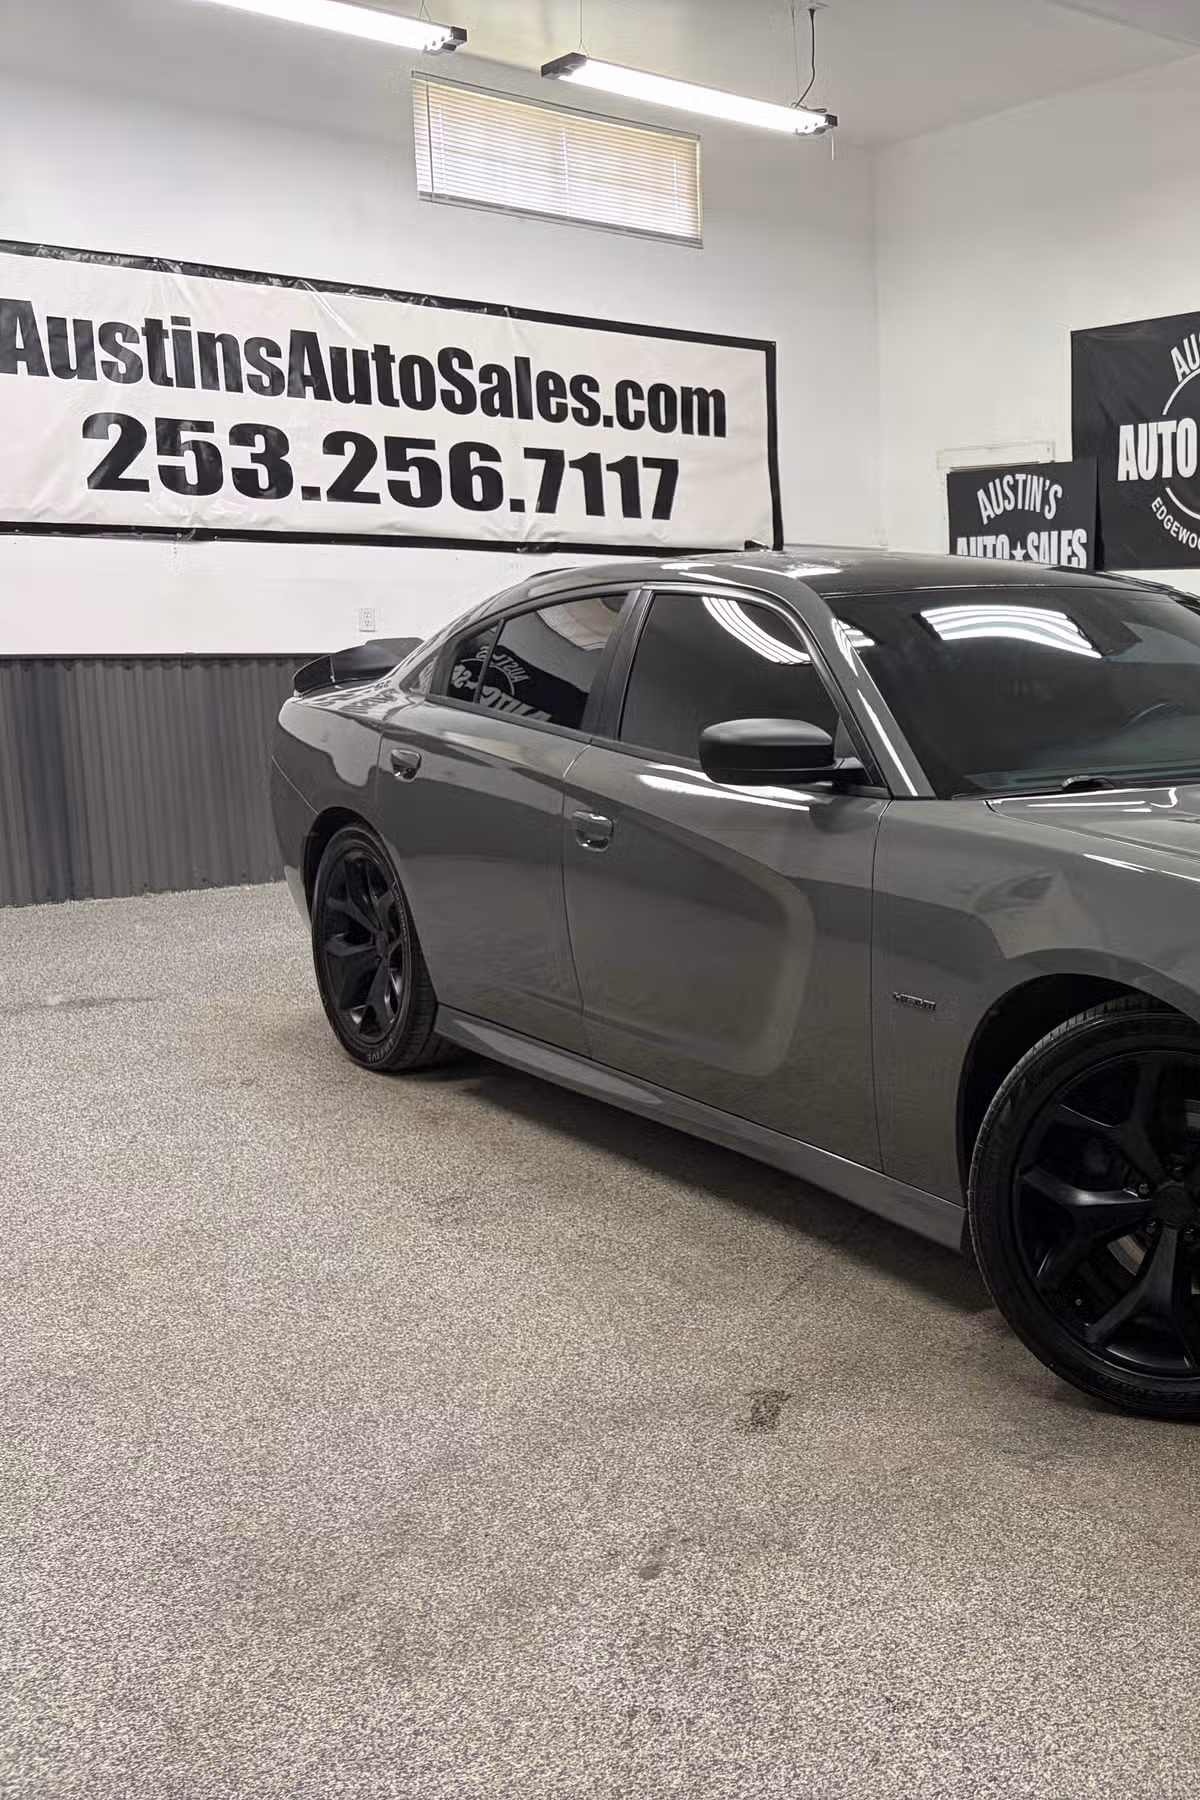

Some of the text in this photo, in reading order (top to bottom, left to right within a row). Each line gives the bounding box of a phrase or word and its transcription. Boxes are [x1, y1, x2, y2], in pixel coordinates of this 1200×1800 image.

[0, 297, 728, 439] AustinsAutoSales.com
[81, 412, 680, 521] 253.256.7117
[1117, 417, 1198, 482] AUTO
[976, 473, 1063, 525] AUSTIN'S
